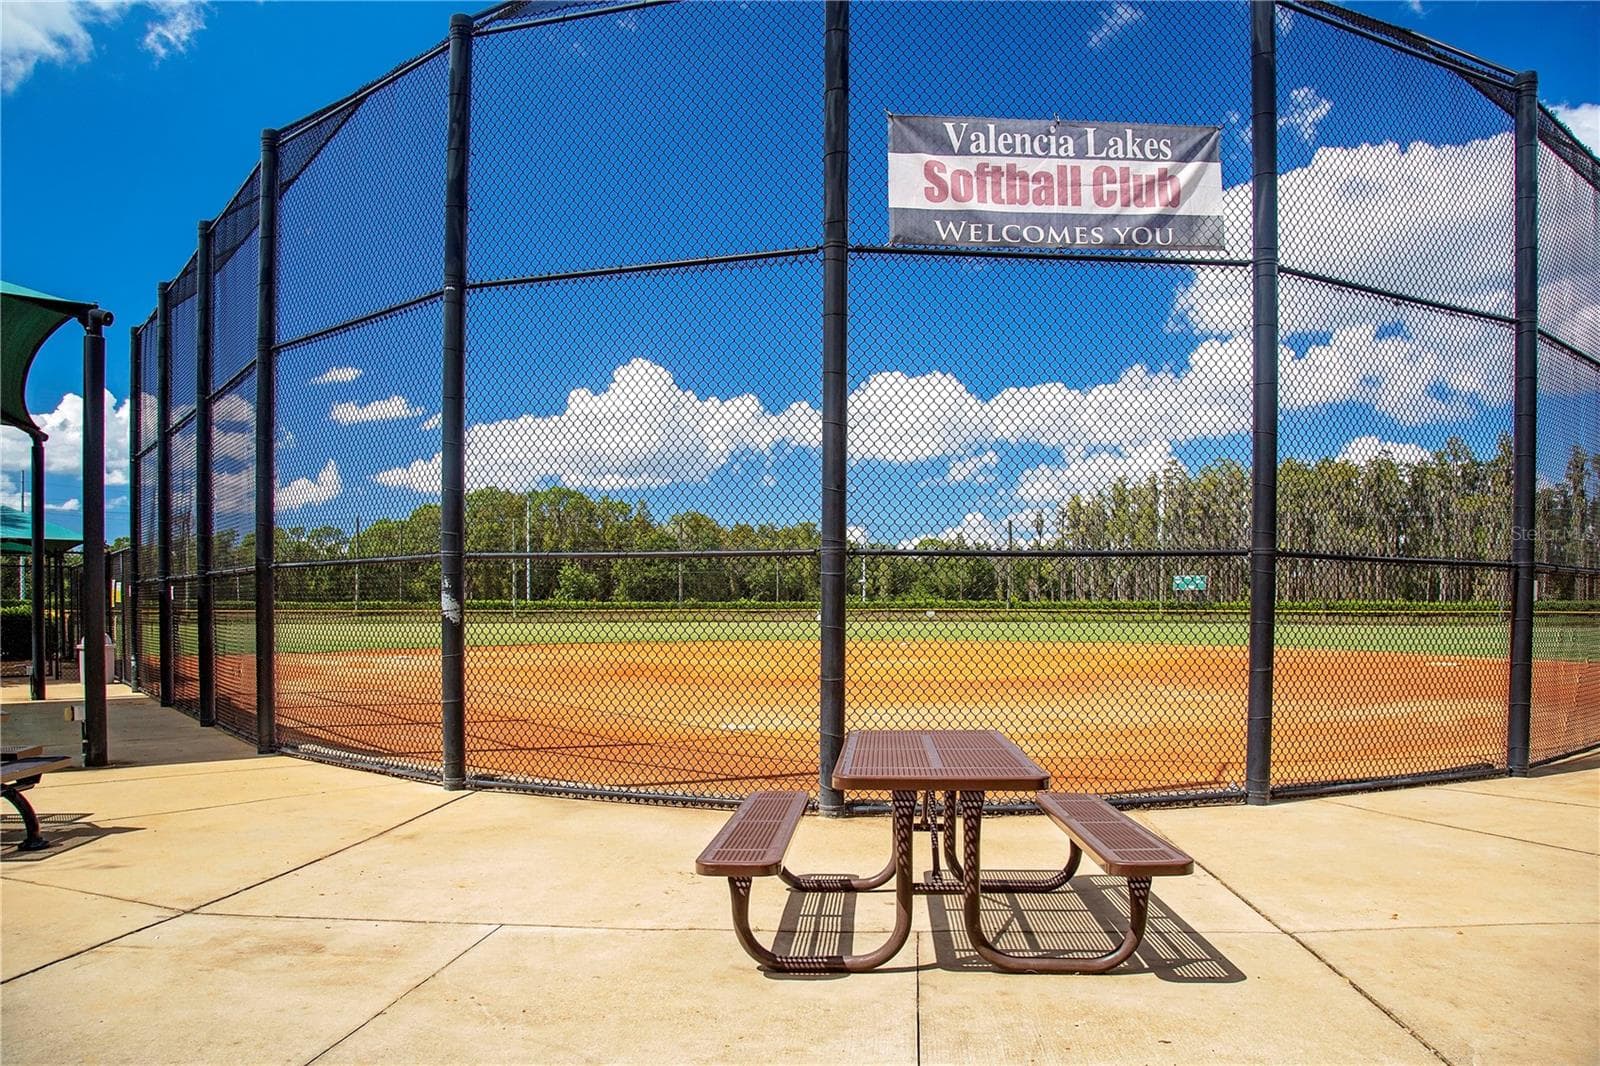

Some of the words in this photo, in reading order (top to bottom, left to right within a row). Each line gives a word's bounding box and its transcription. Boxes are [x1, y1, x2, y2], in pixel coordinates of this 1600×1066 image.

[943, 122, 1075, 157] Valencia
[1086, 127, 1172, 160] Lakes
[923, 160, 1081, 207] Softball
[1092, 165, 1181, 208] Club
[934, 220, 1103, 245] WELCOMES
[1112, 227, 1173, 246] YOU
